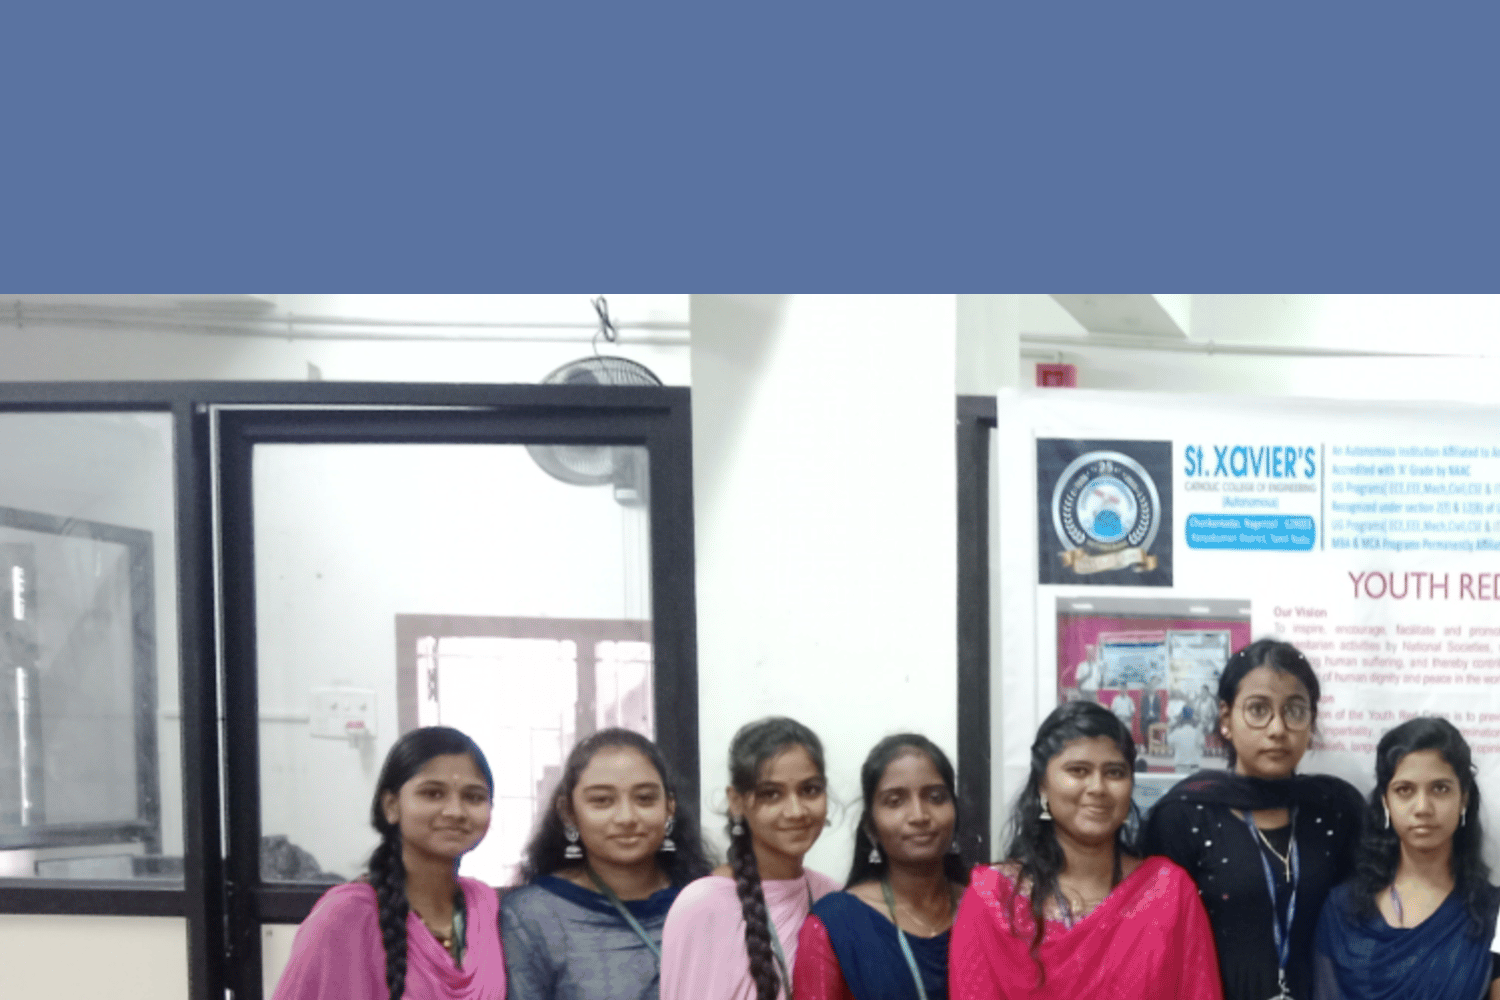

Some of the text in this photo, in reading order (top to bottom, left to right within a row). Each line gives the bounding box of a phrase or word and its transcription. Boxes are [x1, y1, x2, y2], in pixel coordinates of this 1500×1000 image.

[1345, 445, 1396, 457] Autonomous
[1398, 446, 1439, 457] Institution
[1442, 445, 1478, 458] Affiliated
[1481, 447, 1489, 458] to
[1332, 464, 1375, 475] Accredited
[1377, 463, 1395, 475] with
[1409, 464, 1433, 476] Grade
[1436, 465, 1446, 477] by
[1184, 481, 1317, 493] CATHOLIC COLLEGE OF ENGINEERING
[1379, 501, 1402, 514] under
[1405, 502, 1434, 514] section
[1486, 502, 1494, 514] of
[1382, 538, 1420, 552] Programs
[1348, 570, 1448, 600] YOUTH
[1273, 606, 1328, 618] Our Vision
[1274, 622, 1286, 634] To
[1396, 624, 1436, 636] facilitate
[1444, 626, 1462, 636] and
[1386, 641, 1397, 653] by
[1402, 642, 1441, 652] National
[1325, 656, 1357, 666] human
[1410, 658, 1428, 666] and
[1432, 658, 1468, 670] thereby
[1335, 672, 1367, 682] human
[1369, 674, 1400, 685] dignity
[1403, 674, 1421, 683] and
[1423, 675, 1452, 686] peace
[1455, 674, 1463, 684] in
[1466, 674, 1481, 684] the
[1336, 709, 1345, 720] of
[1349, 710, 1363, 720] the
[1369, 710, 1394, 720] Youth
[1454, 712, 1462, 722] is
[1466, 712, 1475, 722] to
